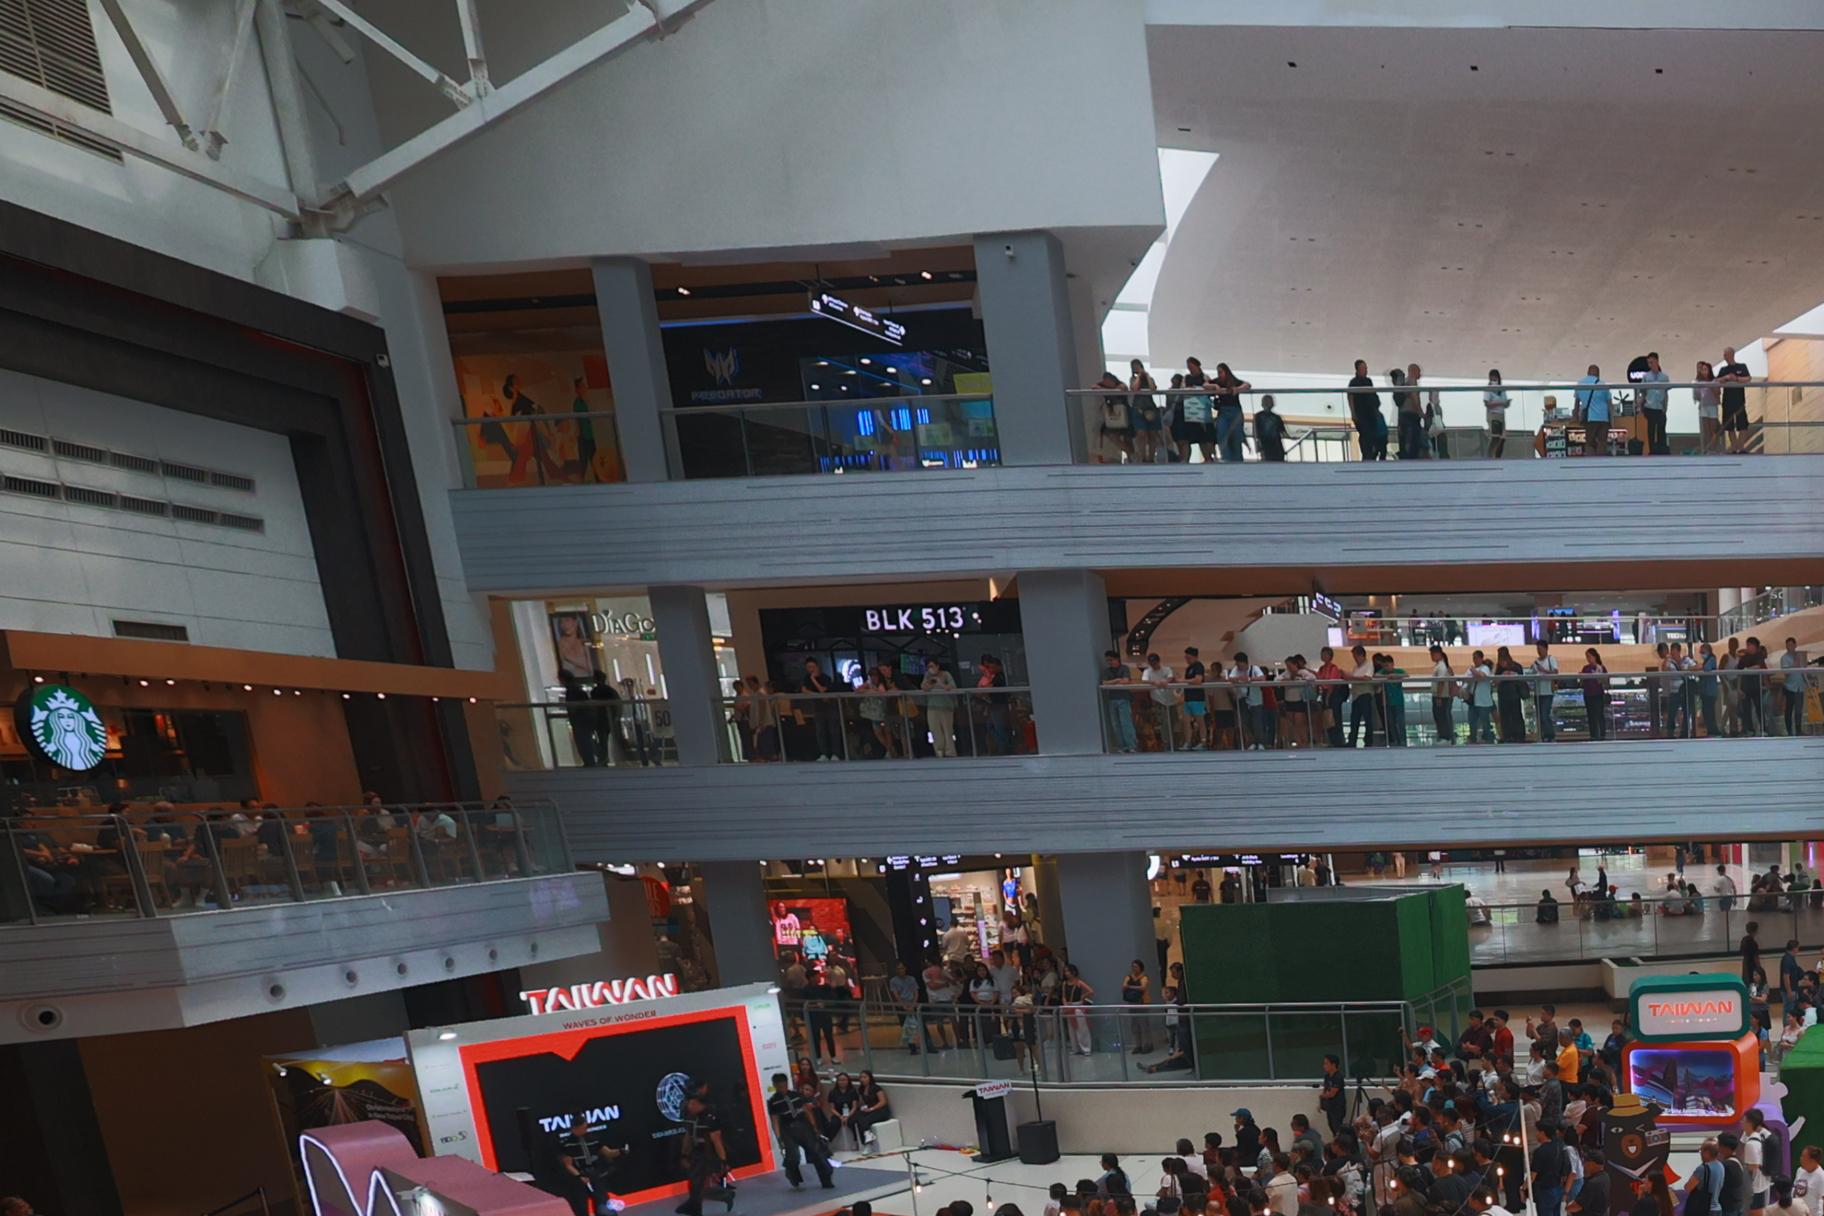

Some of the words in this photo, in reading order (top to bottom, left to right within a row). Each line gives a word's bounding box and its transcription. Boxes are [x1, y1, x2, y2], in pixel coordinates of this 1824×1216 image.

[866, 608, 914, 631] BLK
[921, 606, 964, 630] 513
[520, 972, 681, 1016] TAIWAN
[562, 1018, 597, 1030] WAVES
[600, 1015, 612, 1025] OF
[614, 1009, 657, 1023] WONDER
[1648, 1000, 1732, 1017] TAIWAN
